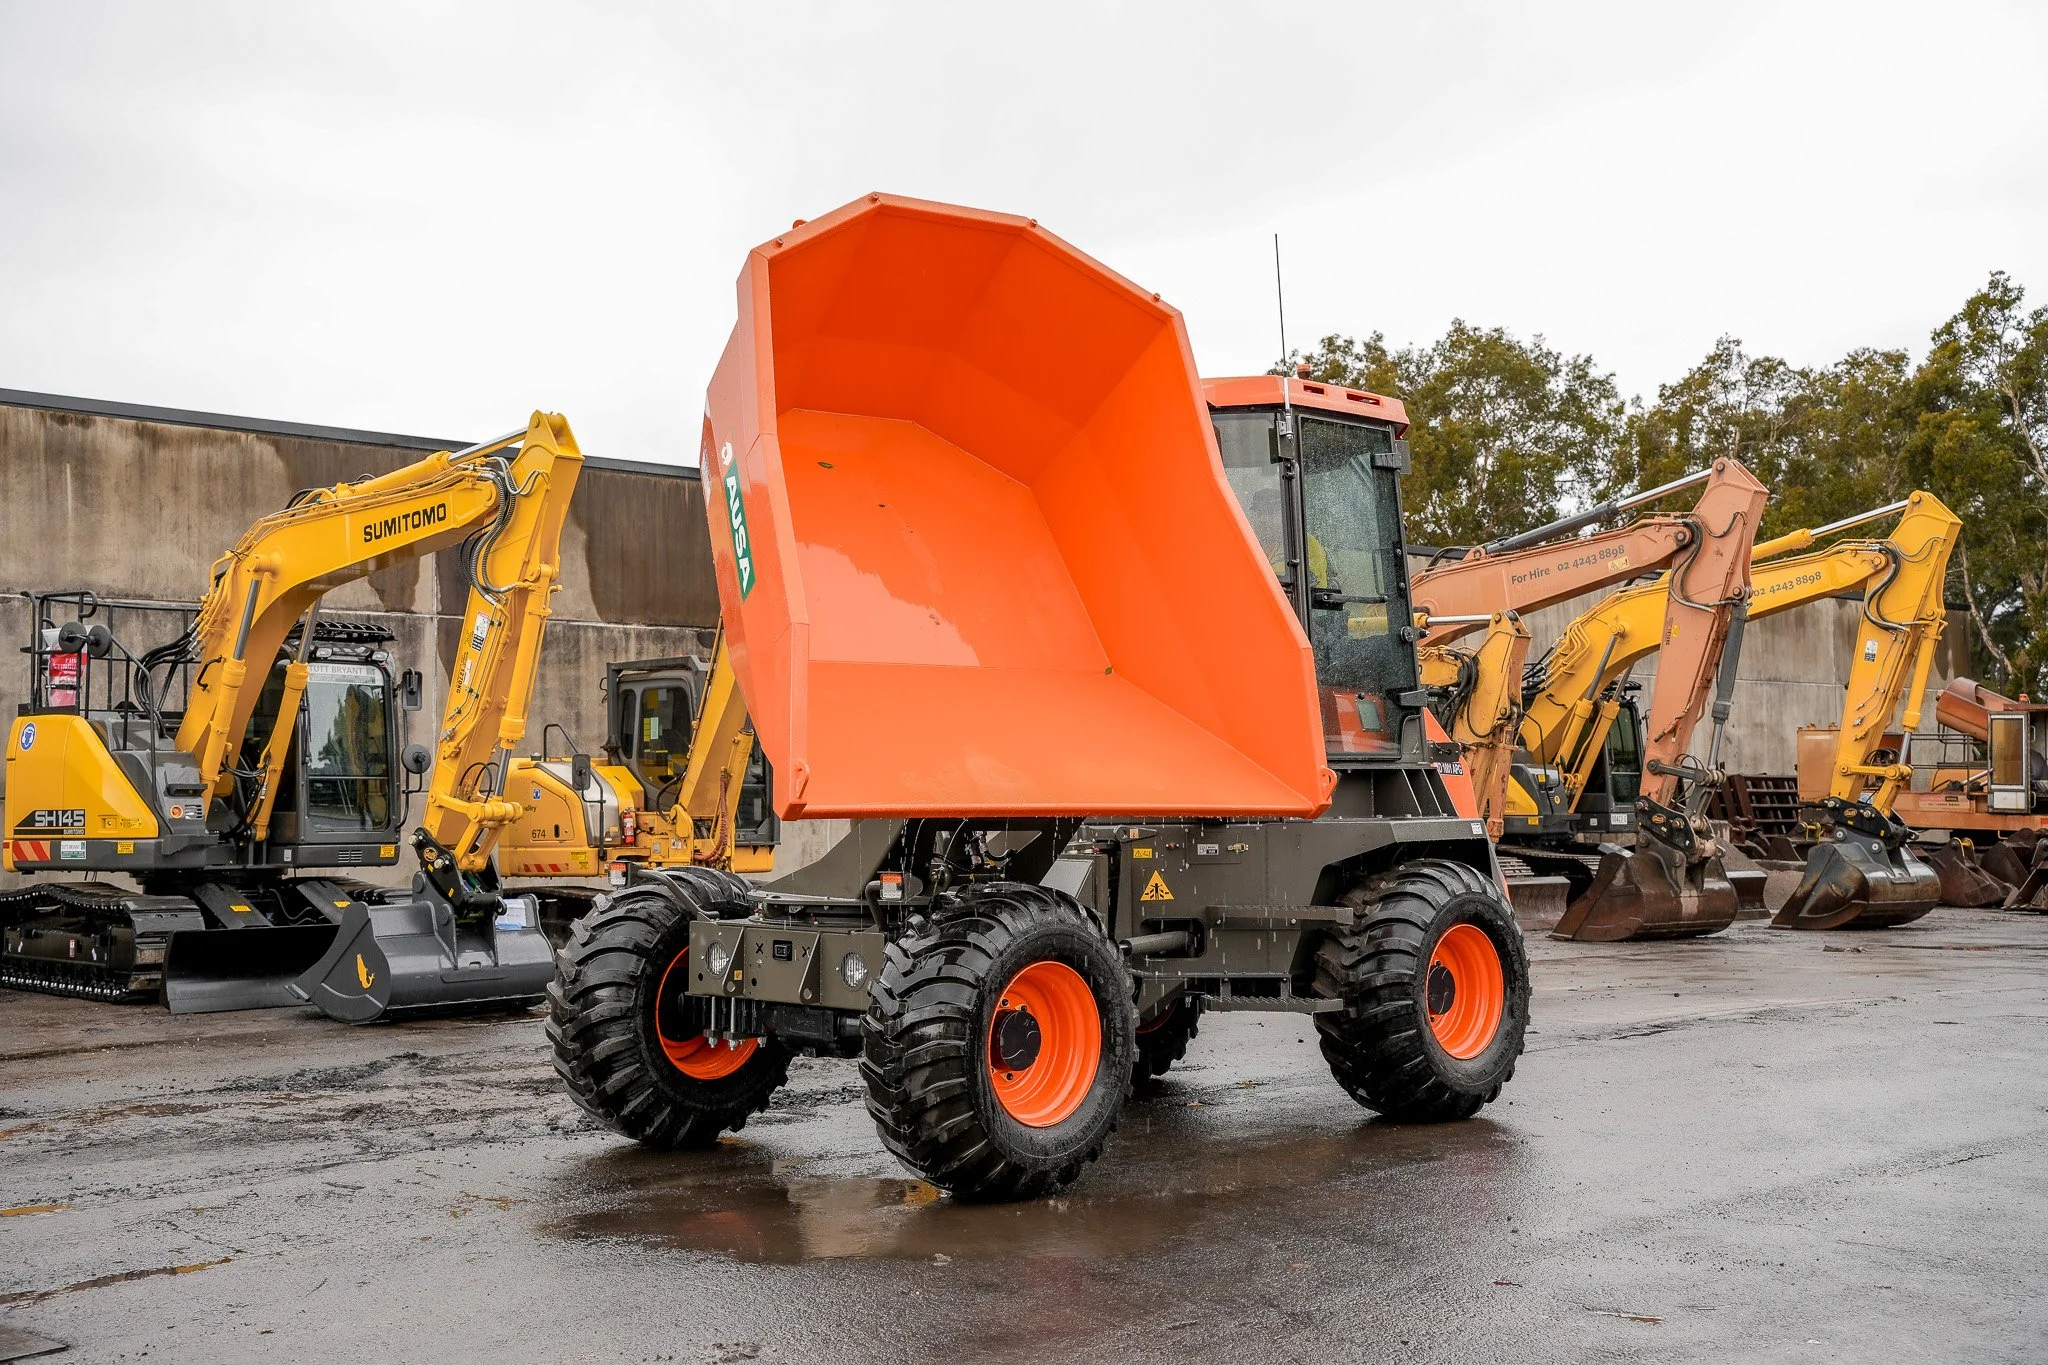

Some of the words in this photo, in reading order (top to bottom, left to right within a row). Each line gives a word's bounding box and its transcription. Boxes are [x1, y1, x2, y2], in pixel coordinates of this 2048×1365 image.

[363, 503, 446, 543] SUMITOMO
[726, 475, 750, 594] AUSA
[1511, 574, 1527, 585] For
[1529, 567, 1551, 580] Hire
[1557, 562, 1570, 572] 02
[1572, 554, 1598, 569] 4243
[1598, 544, 1625, 560] 8898
[1769, 580, 1795, 594] 4243
[1795, 571, 1822, 586] 8898
[331, 666, 363, 675] BRYANT
[34, 810, 85, 827] SH145
[63, 828, 85, 836] SUMITOMO
[531, 829, 546, 839] 674
